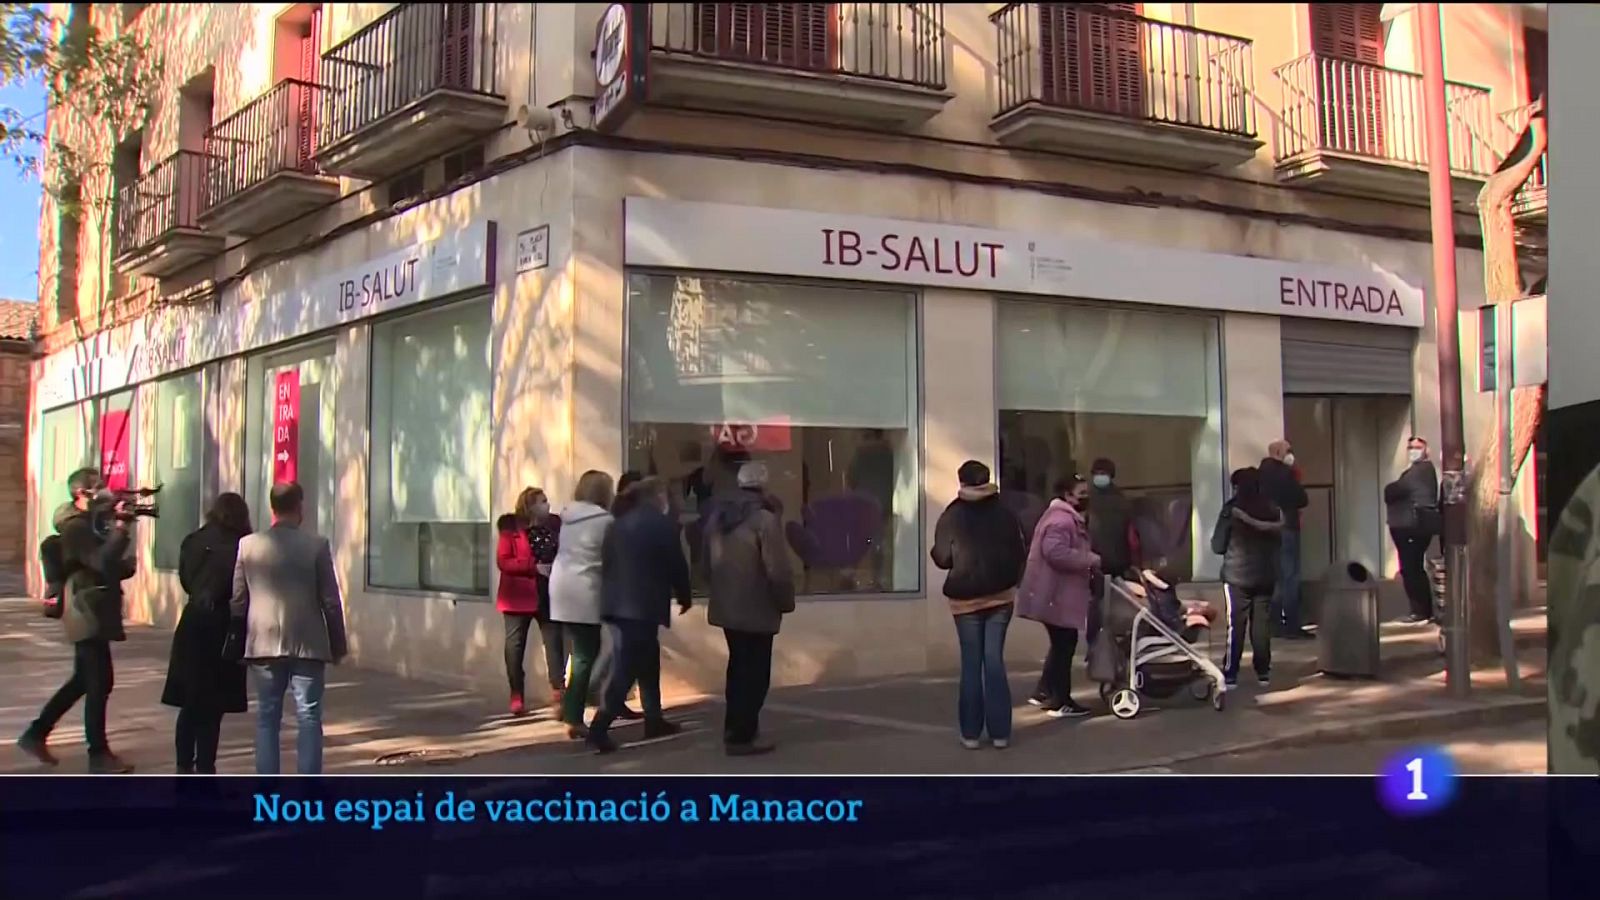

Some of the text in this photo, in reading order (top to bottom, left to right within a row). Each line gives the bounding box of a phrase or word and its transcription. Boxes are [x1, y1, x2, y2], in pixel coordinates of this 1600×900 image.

[821, 229, 1005, 278] IB-SALUT
[338, 257, 419, 312] IB-SALUT
[1279, 276, 1404, 316] ENTRADA
[279, 382, 291, 400] EN
[279, 403, 294, 421] TRA
[277, 425, 290, 443] DA
